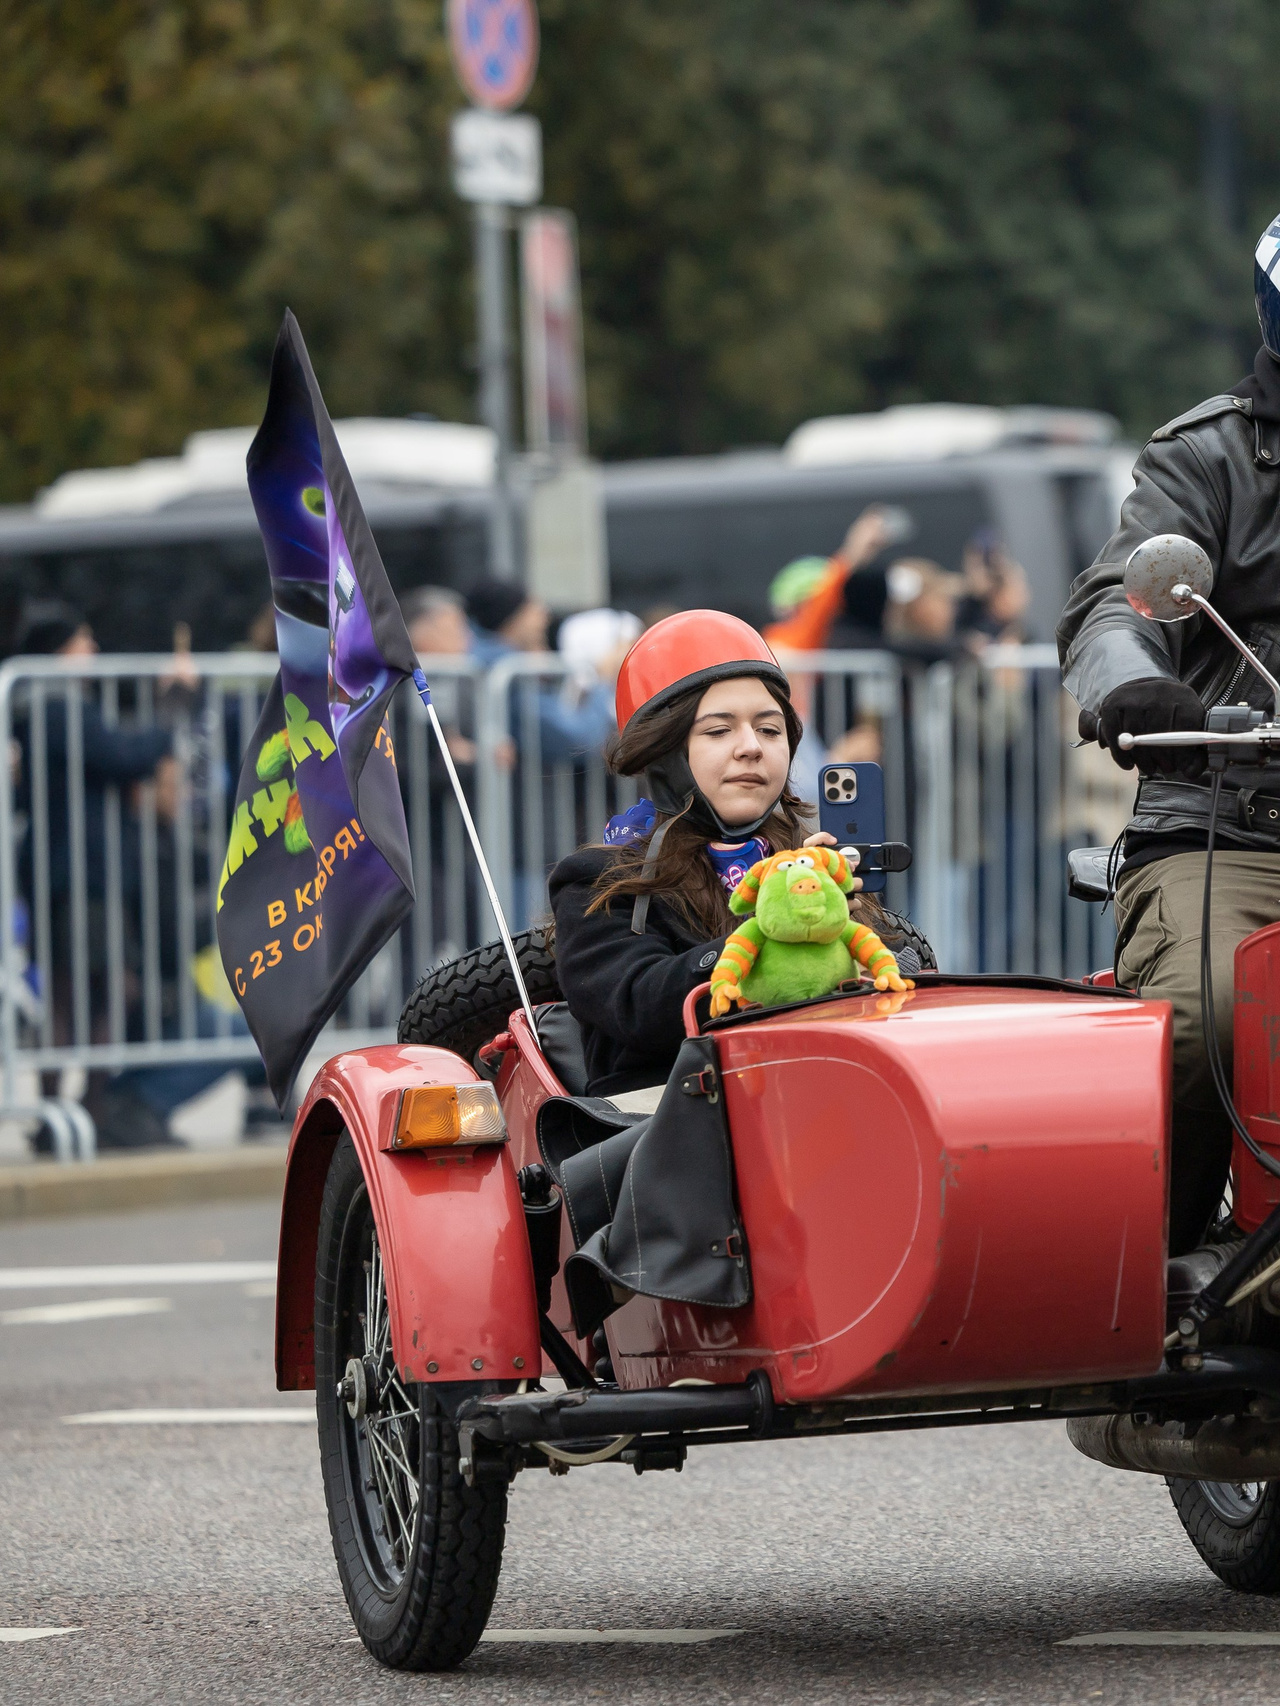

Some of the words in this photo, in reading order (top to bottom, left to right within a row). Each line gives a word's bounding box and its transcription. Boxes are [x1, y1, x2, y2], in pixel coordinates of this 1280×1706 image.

[267, 900, 287, 928] В
[235, 967, 246, 997] С
[250, 939, 283, 979] 23
